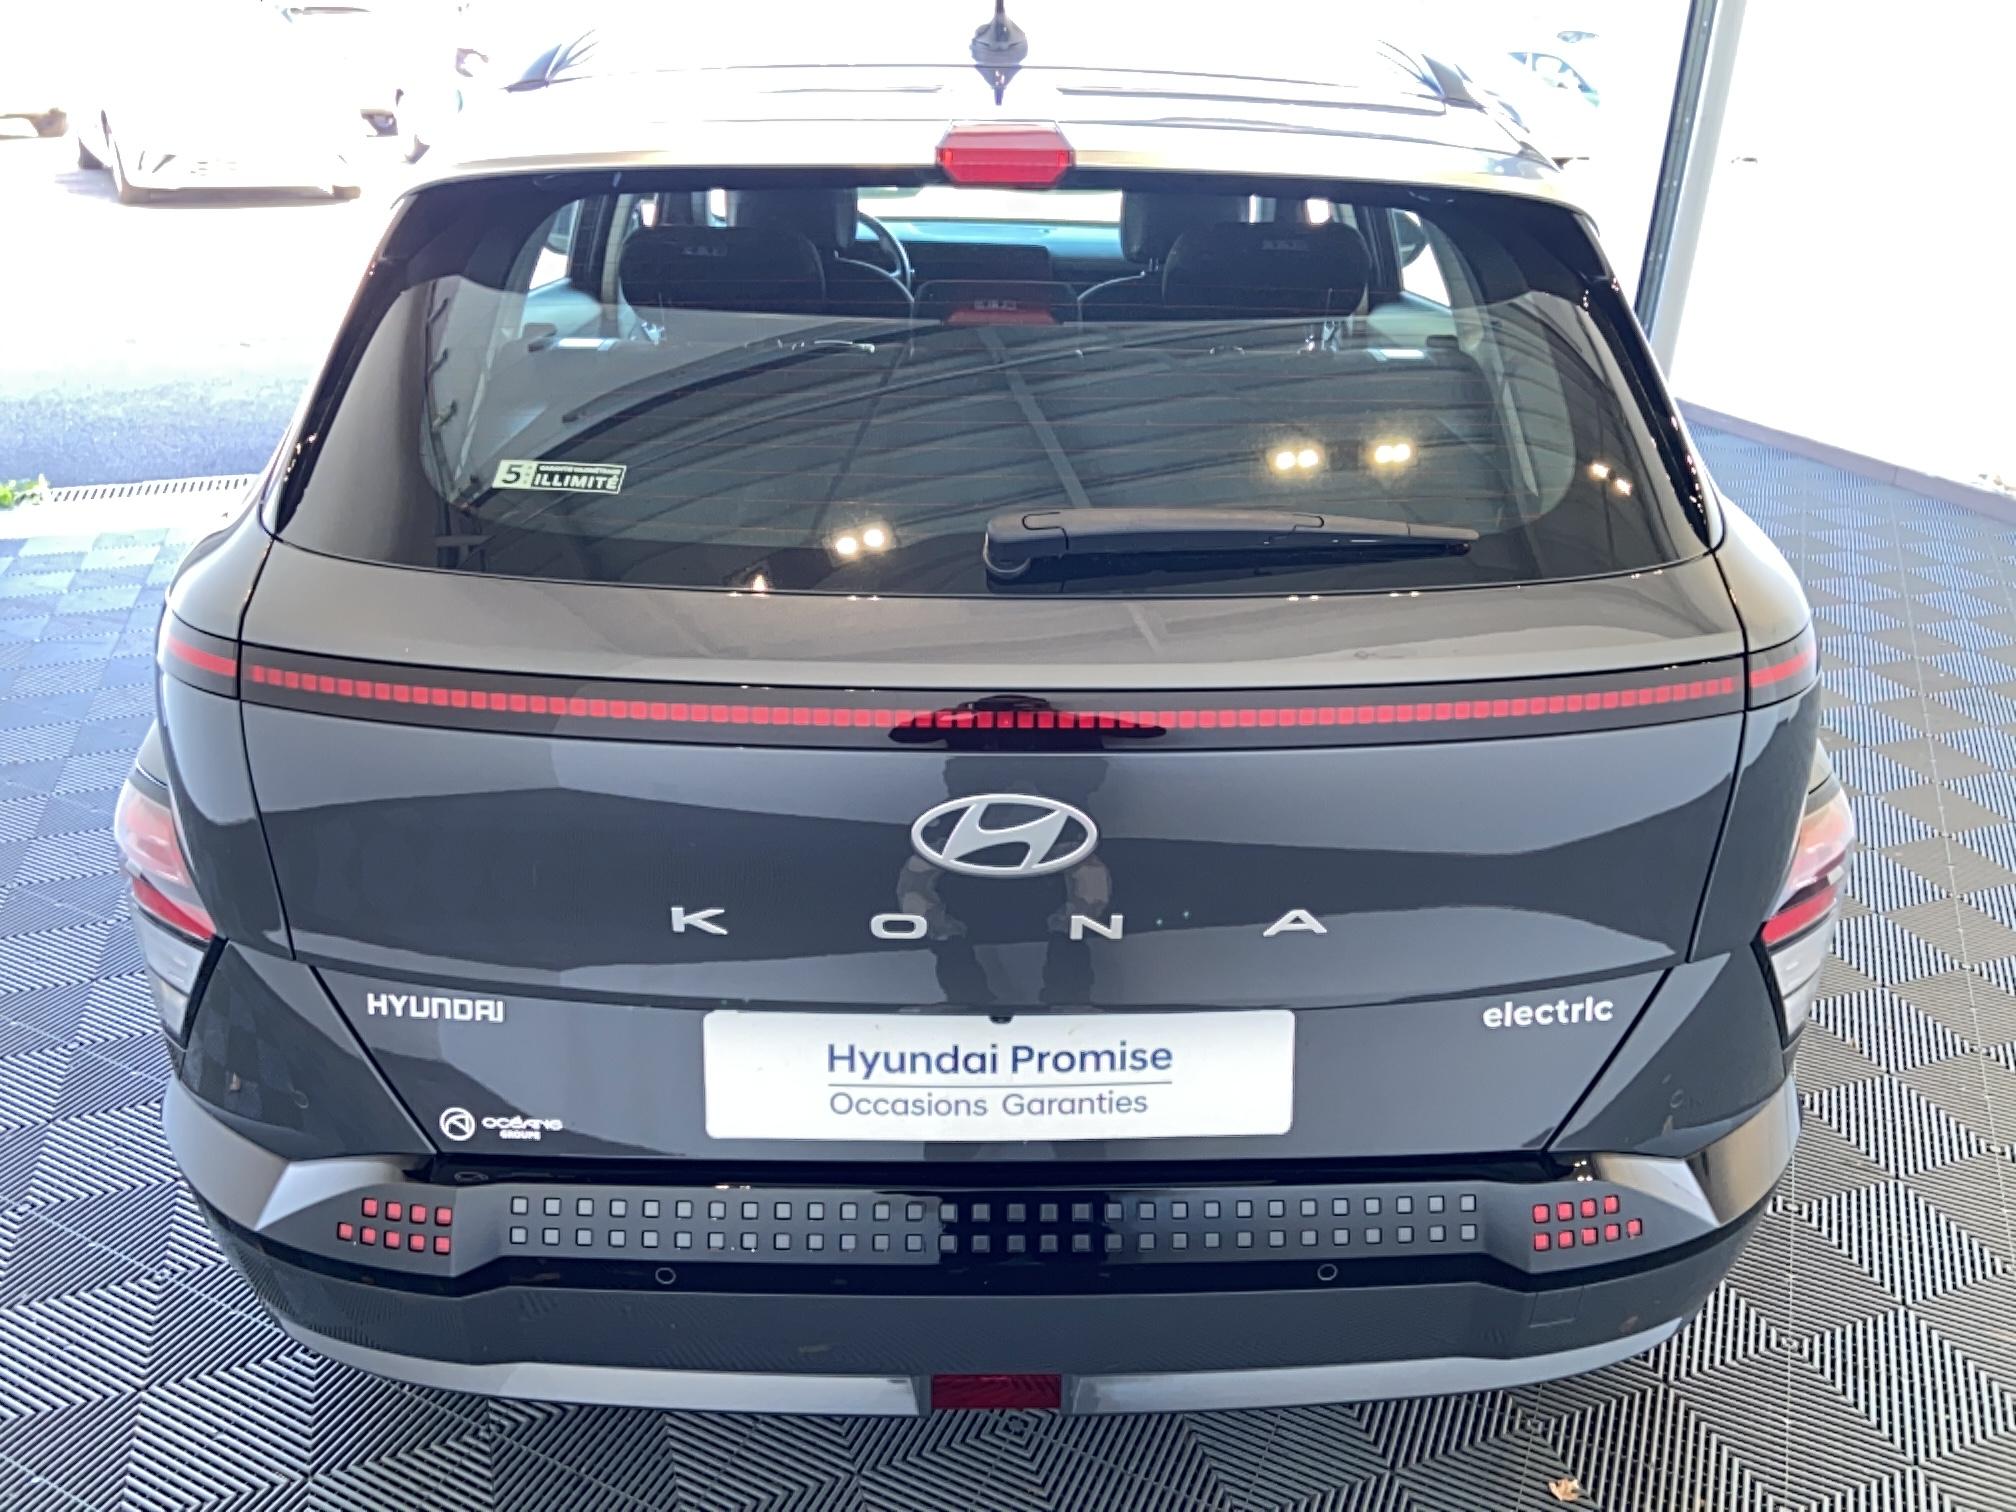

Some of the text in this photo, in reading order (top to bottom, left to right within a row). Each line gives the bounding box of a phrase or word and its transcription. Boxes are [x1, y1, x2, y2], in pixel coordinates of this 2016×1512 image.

[502, 463, 523, 484] 5
[533, 472, 620, 490] ILLIMITÉ
[367, 993, 505, 1024] HYUNDAI
[1482, 995, 1614, 1029] electric
[827, 1039, 1174, 1081] Hyundai Promise
[828, 1089, 1149, 1118] Occasions Garanties
